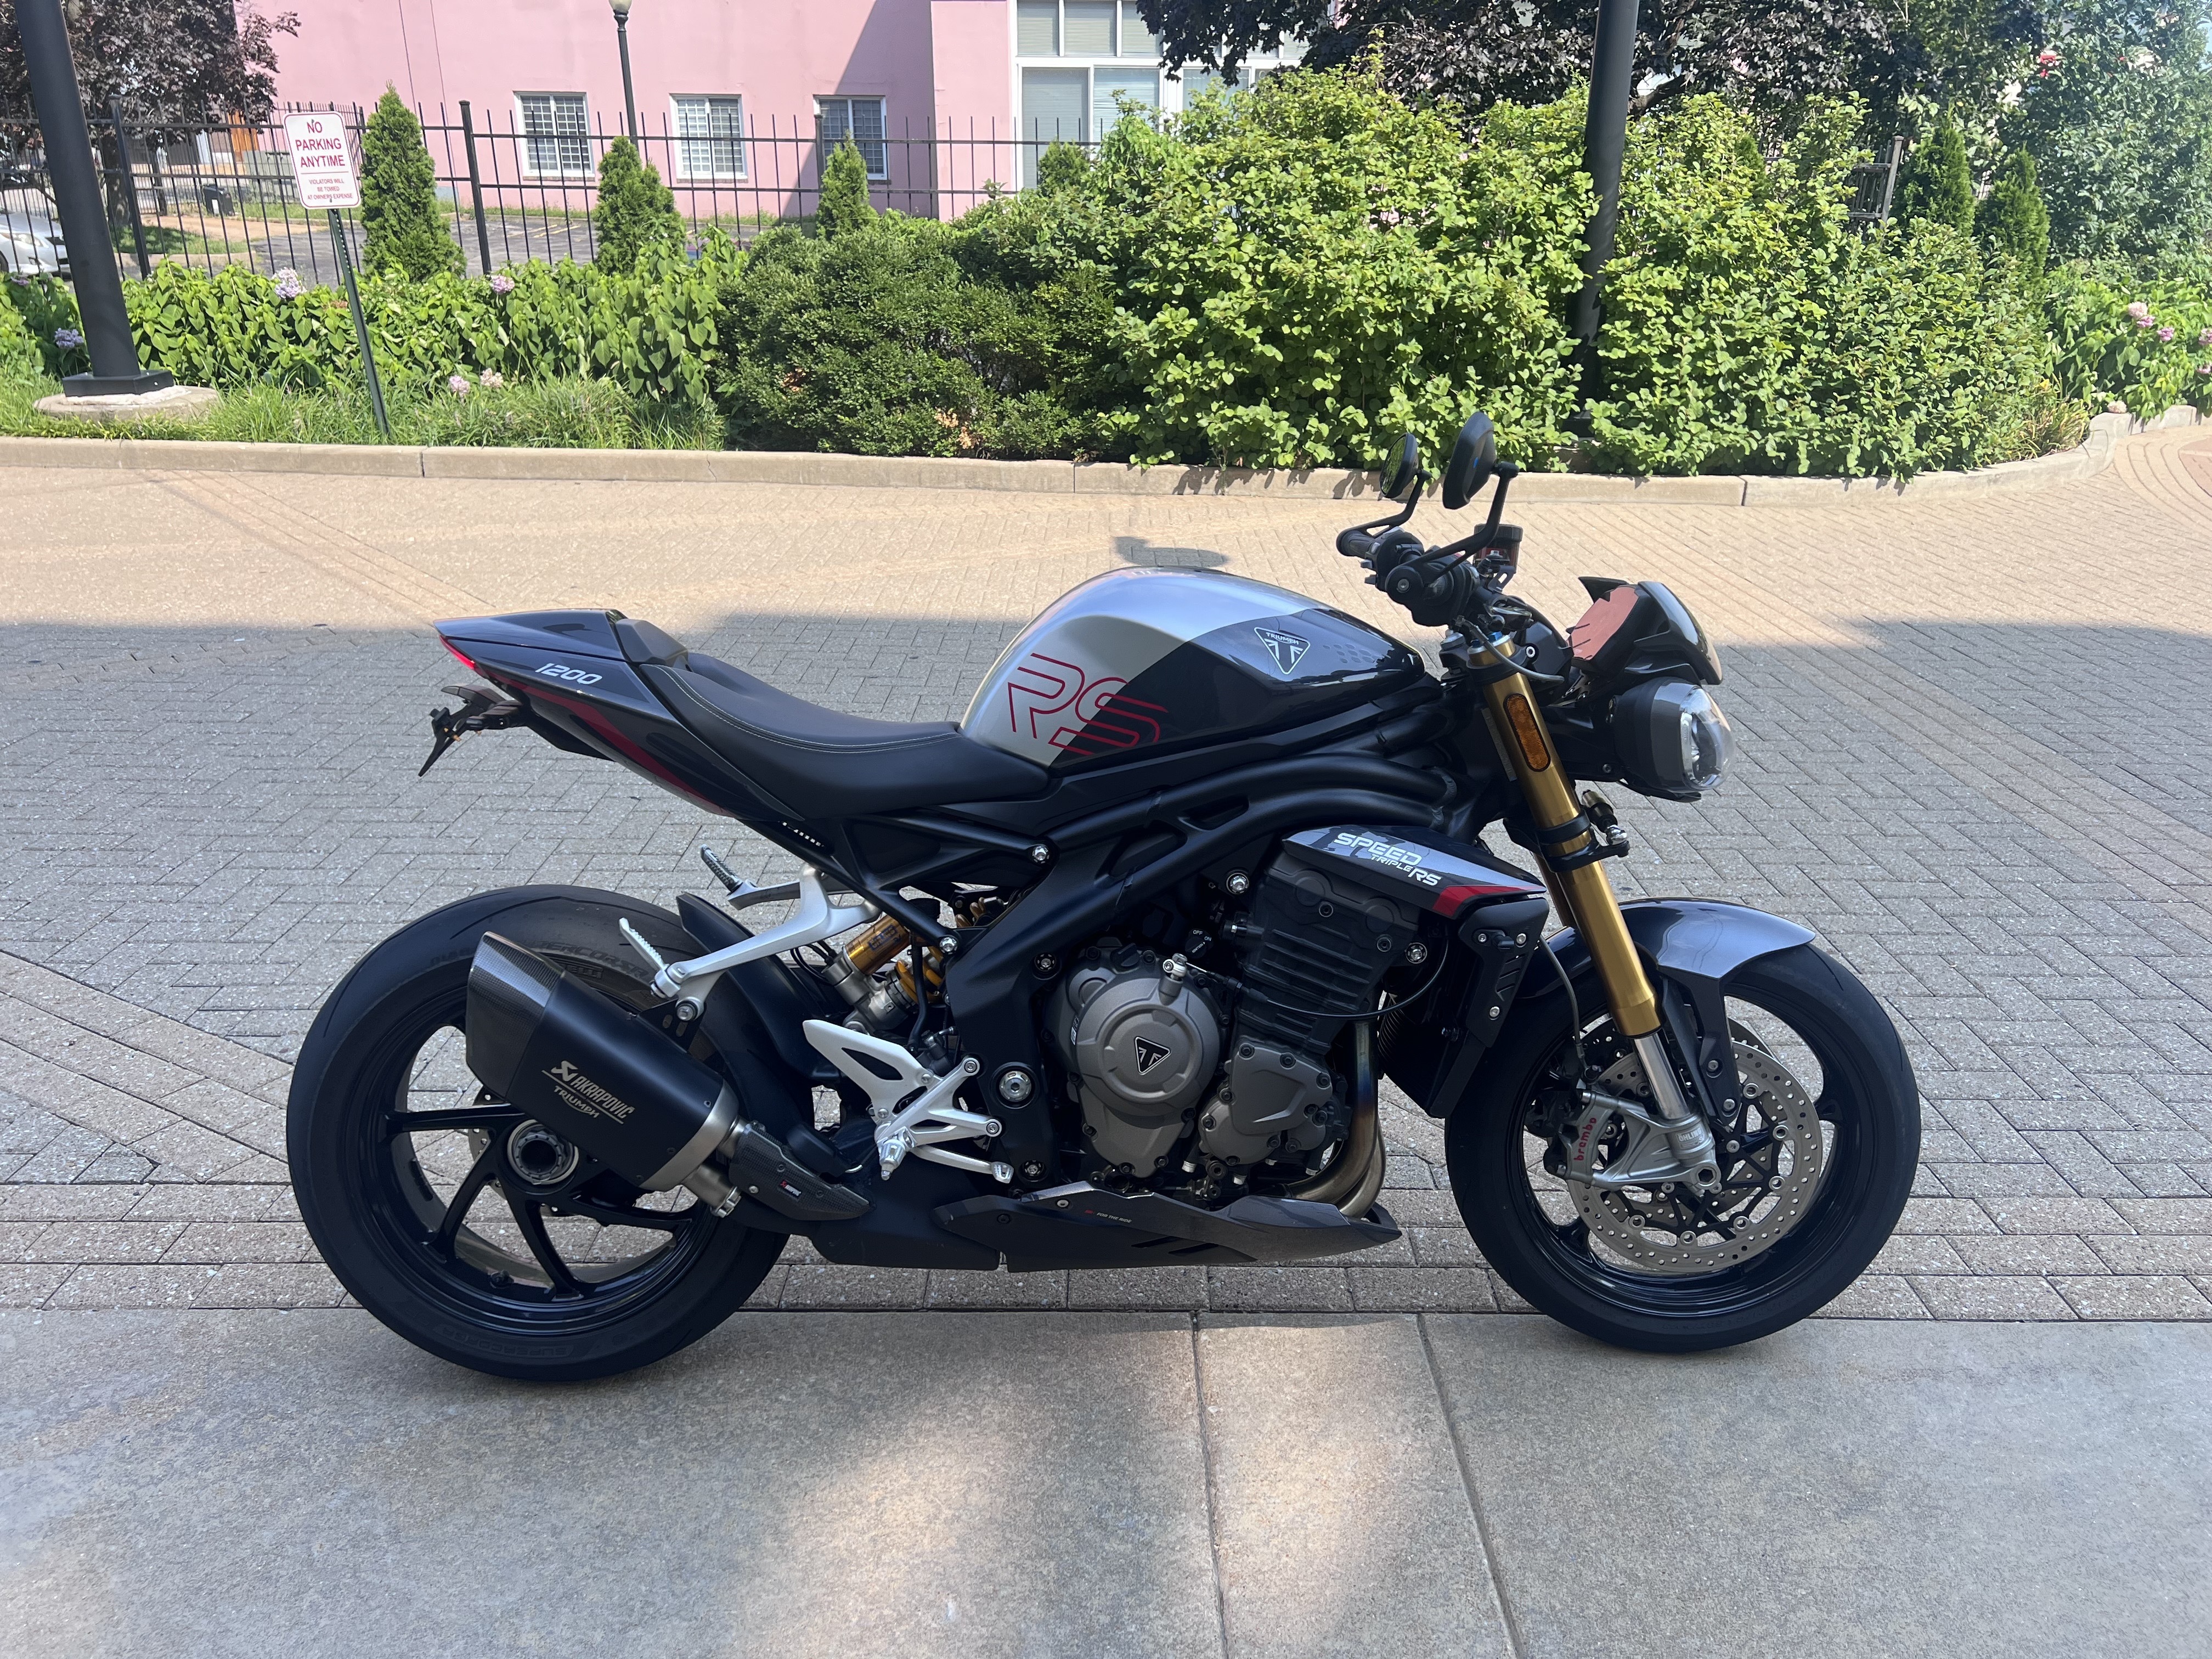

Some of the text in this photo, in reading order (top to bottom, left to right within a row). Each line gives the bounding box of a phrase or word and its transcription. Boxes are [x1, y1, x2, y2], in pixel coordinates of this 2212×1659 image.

[306, 121, 323, 133] NO
[295, 138, 341, 151] PARKING
[300, 155, 346, 167] ANYTIME
[1266, 632, 1299, 645] TRIUMPH
[535, 663, 603, 685] 1200
[1007, 652, 1169, 756] RS
[1334, 832, 1423, 866] SPEED
[1371, 854, 1443, 887] TRIPLE RS
[554, 1085, 600, 1119] TRIUMPH
[1573, 1117, 1597, 1161] brembo
